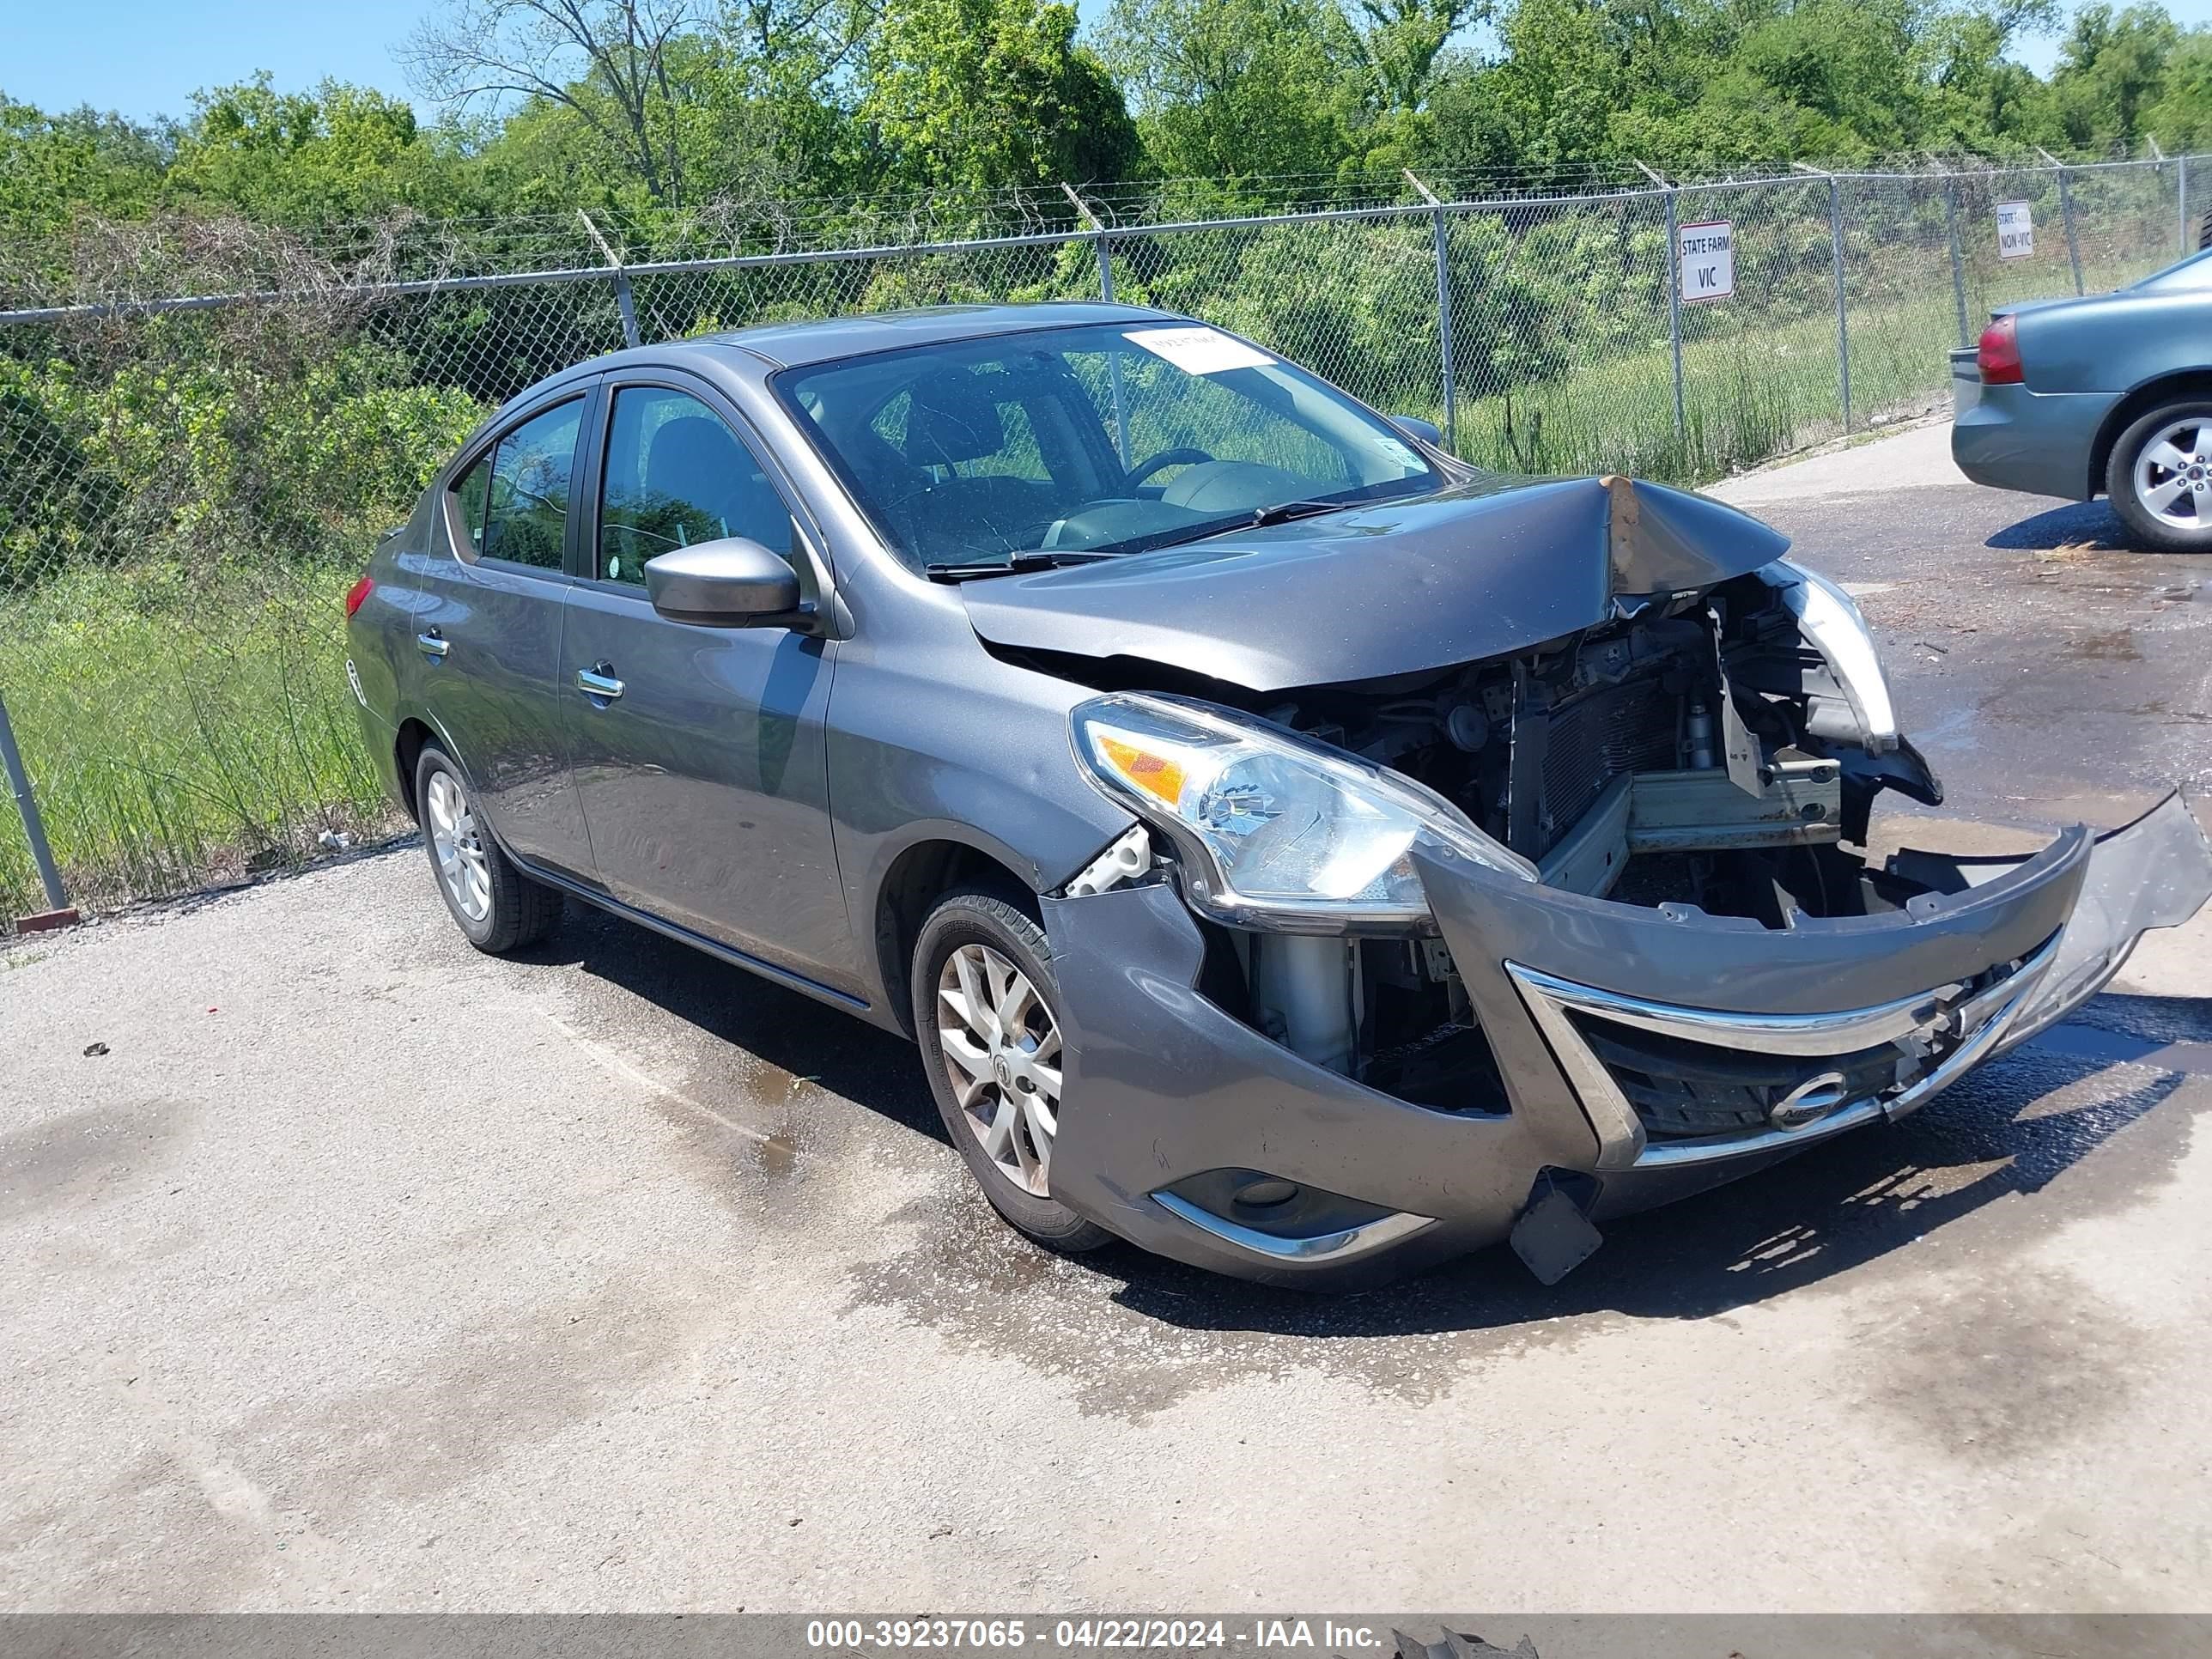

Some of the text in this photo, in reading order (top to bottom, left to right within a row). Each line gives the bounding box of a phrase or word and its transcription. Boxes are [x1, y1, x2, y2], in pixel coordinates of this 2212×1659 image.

[1998, 213, 2014, 225] STATE
[1683, 235, 1729, 256] STATE FARM
[1698, 266, 1717, 289] VIC
